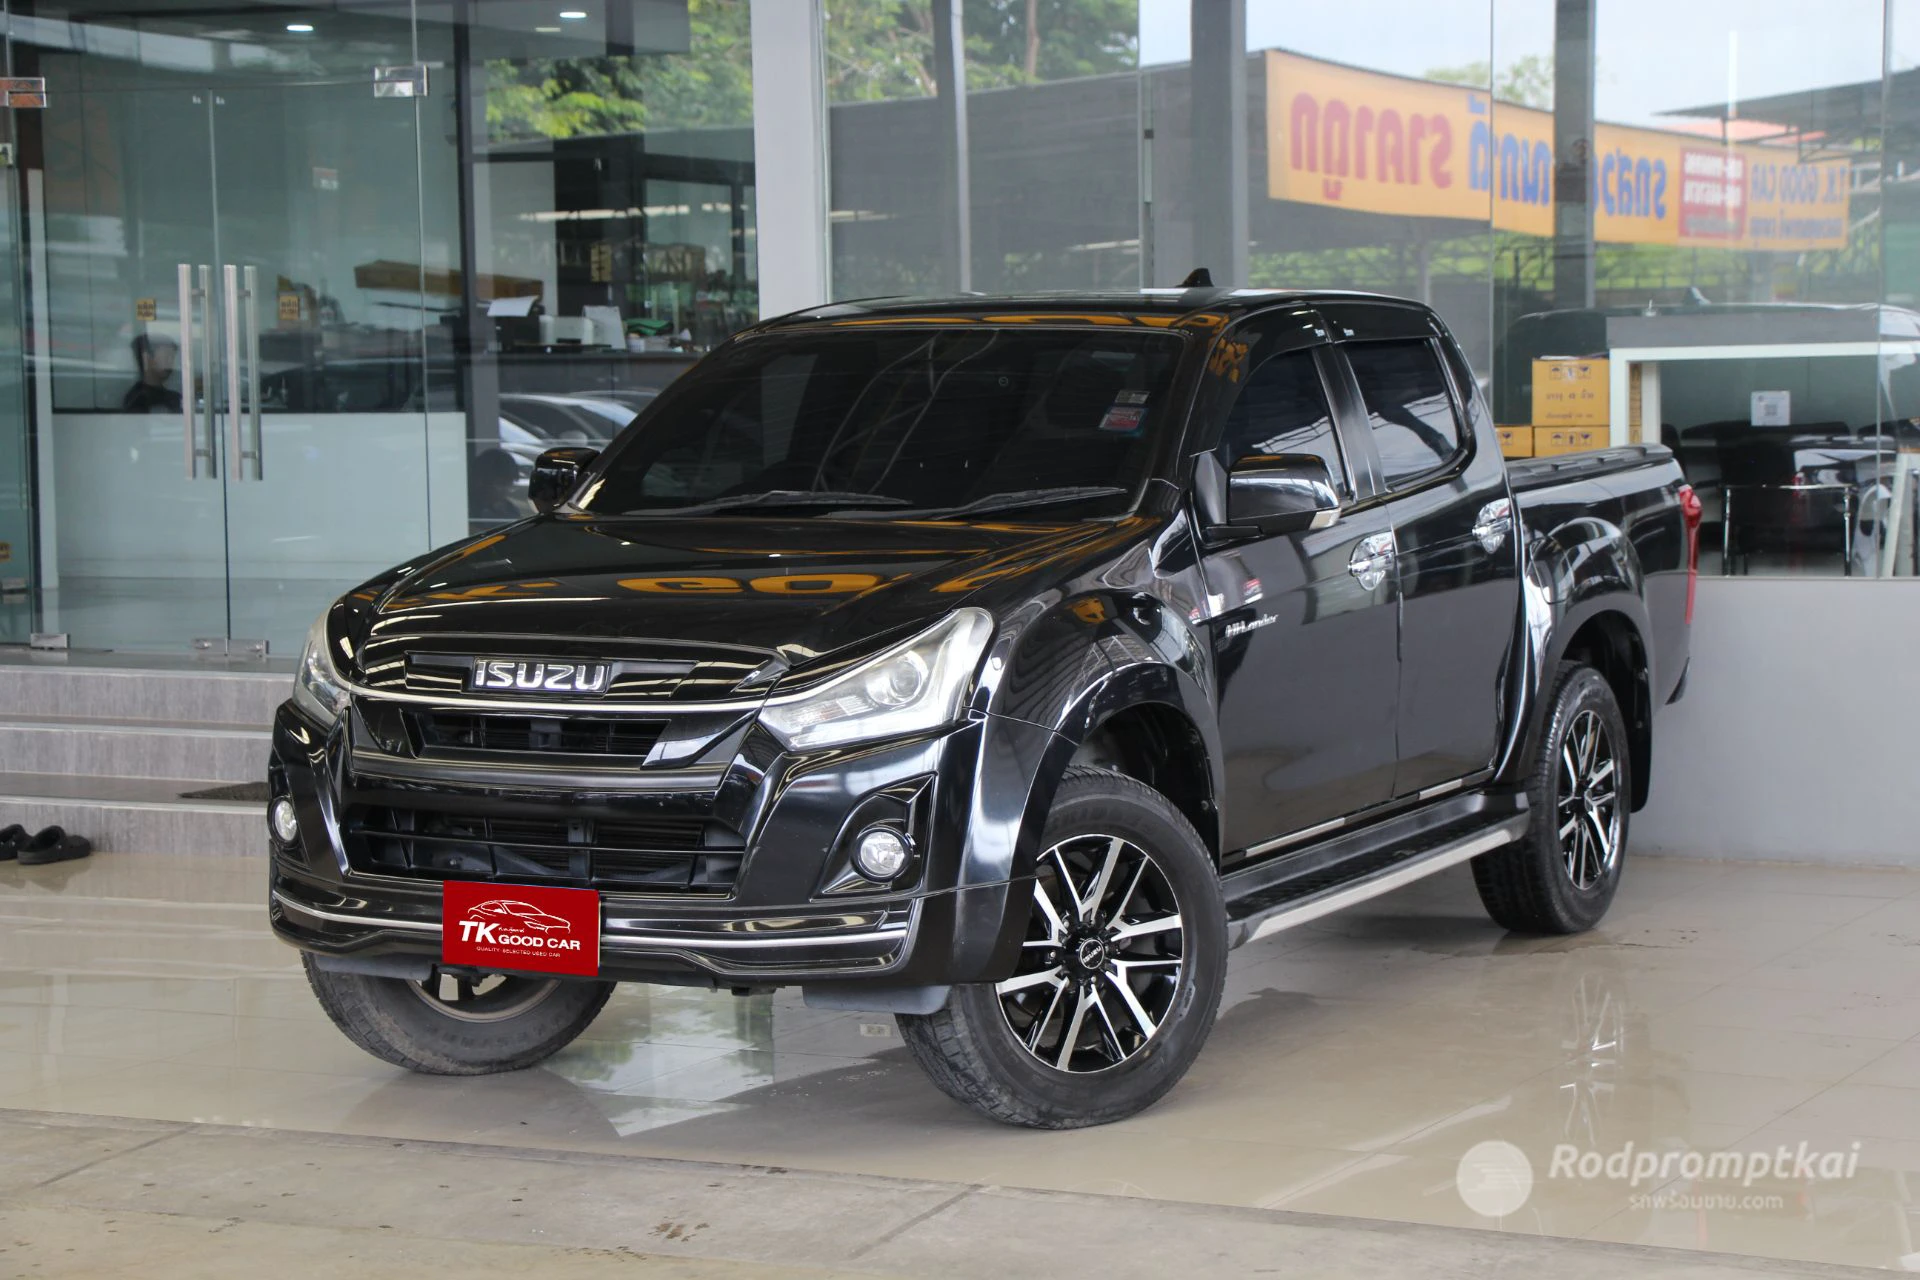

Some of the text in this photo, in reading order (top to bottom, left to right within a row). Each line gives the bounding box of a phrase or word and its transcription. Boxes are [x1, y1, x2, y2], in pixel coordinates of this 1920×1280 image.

[475, 661, 605, 690] ISUZU
[459, 920, 500, 945] TK
[498, 934, 544, 947] GOOD
[547, 938, 581, 951] CAR
[502, 948, 531, 956] SELECTED
[1083, 946, 1102, 963] ISUZU
